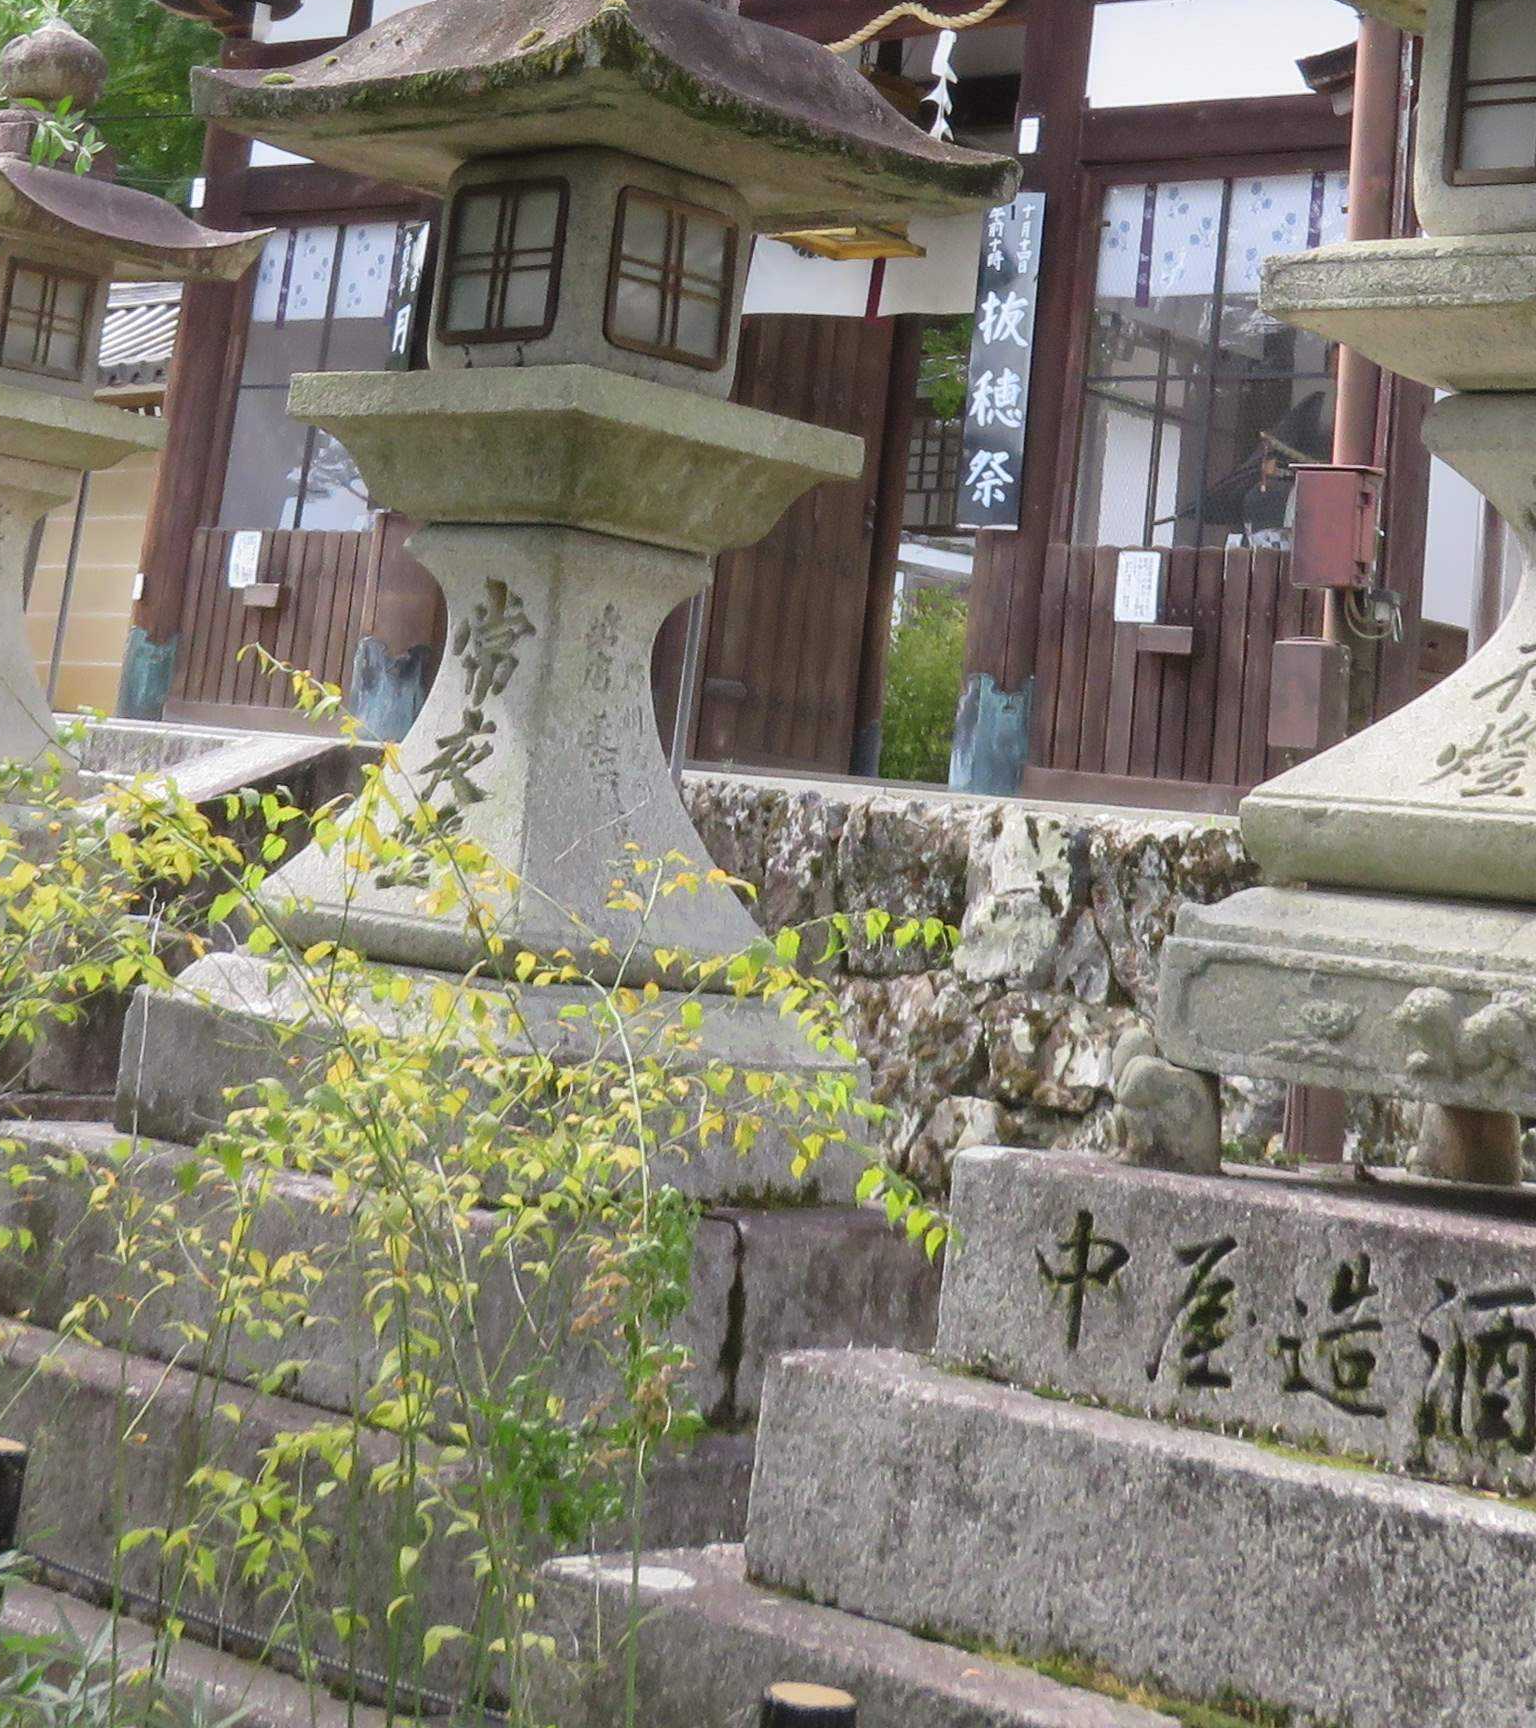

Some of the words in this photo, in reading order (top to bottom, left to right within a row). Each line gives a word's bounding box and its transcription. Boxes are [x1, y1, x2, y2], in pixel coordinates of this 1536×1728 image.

[986, 207, 1006, 271] 午前十時
[1016, 204, 1036, 274] 十月十四日
[965, 290, 1030, 508] 抜穂祭
